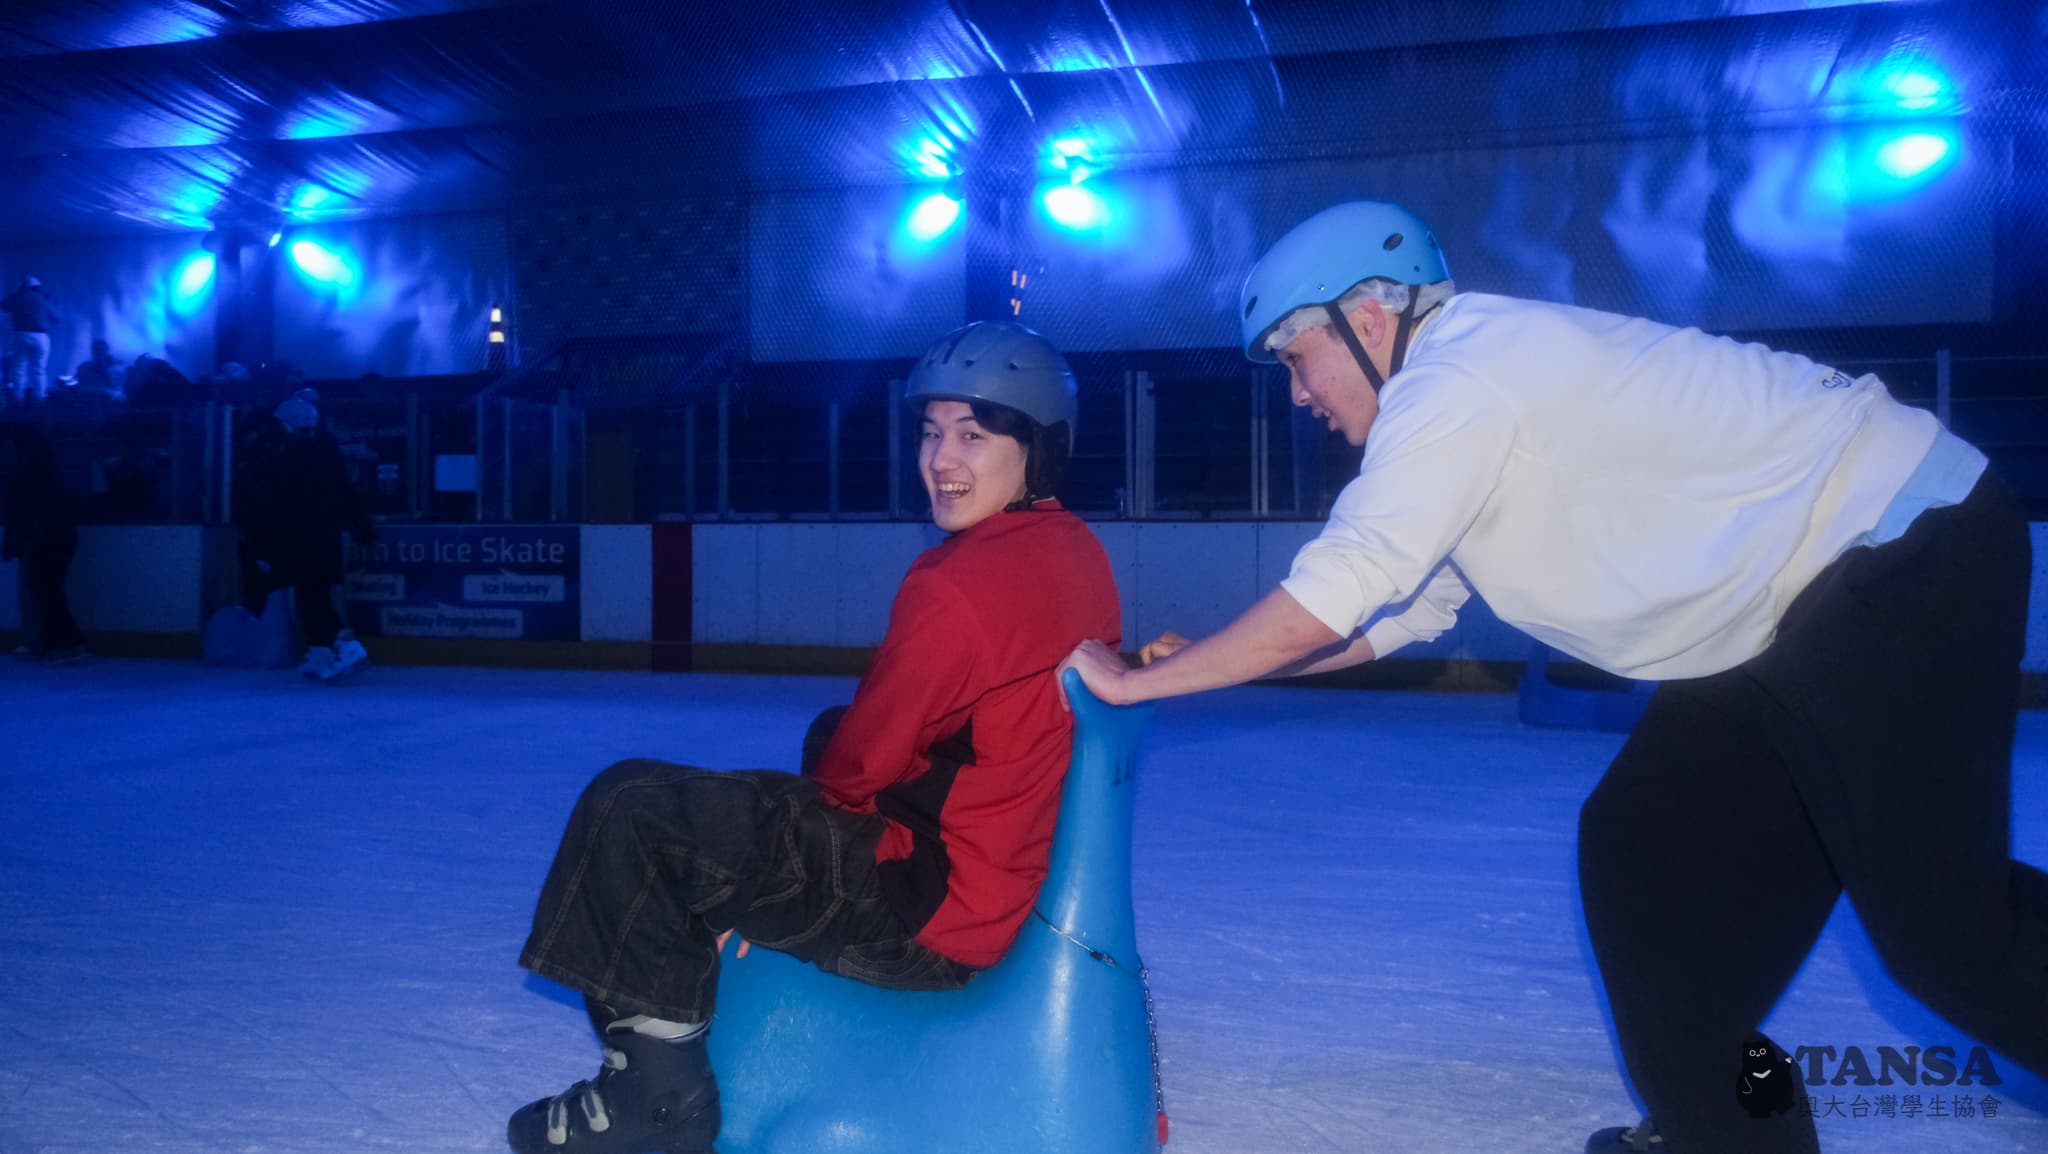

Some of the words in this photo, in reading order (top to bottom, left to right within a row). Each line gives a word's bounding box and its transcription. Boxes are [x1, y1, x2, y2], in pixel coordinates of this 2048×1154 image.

[346, 543, 389, 562] arn
[399, 539, 426, 562] to
[434, 538, 473, 562] Ice
[481, 536, 566, 564] Skate
[481, 581, 501, 595] Ice
[503, 581, 549, 599] Hockey
